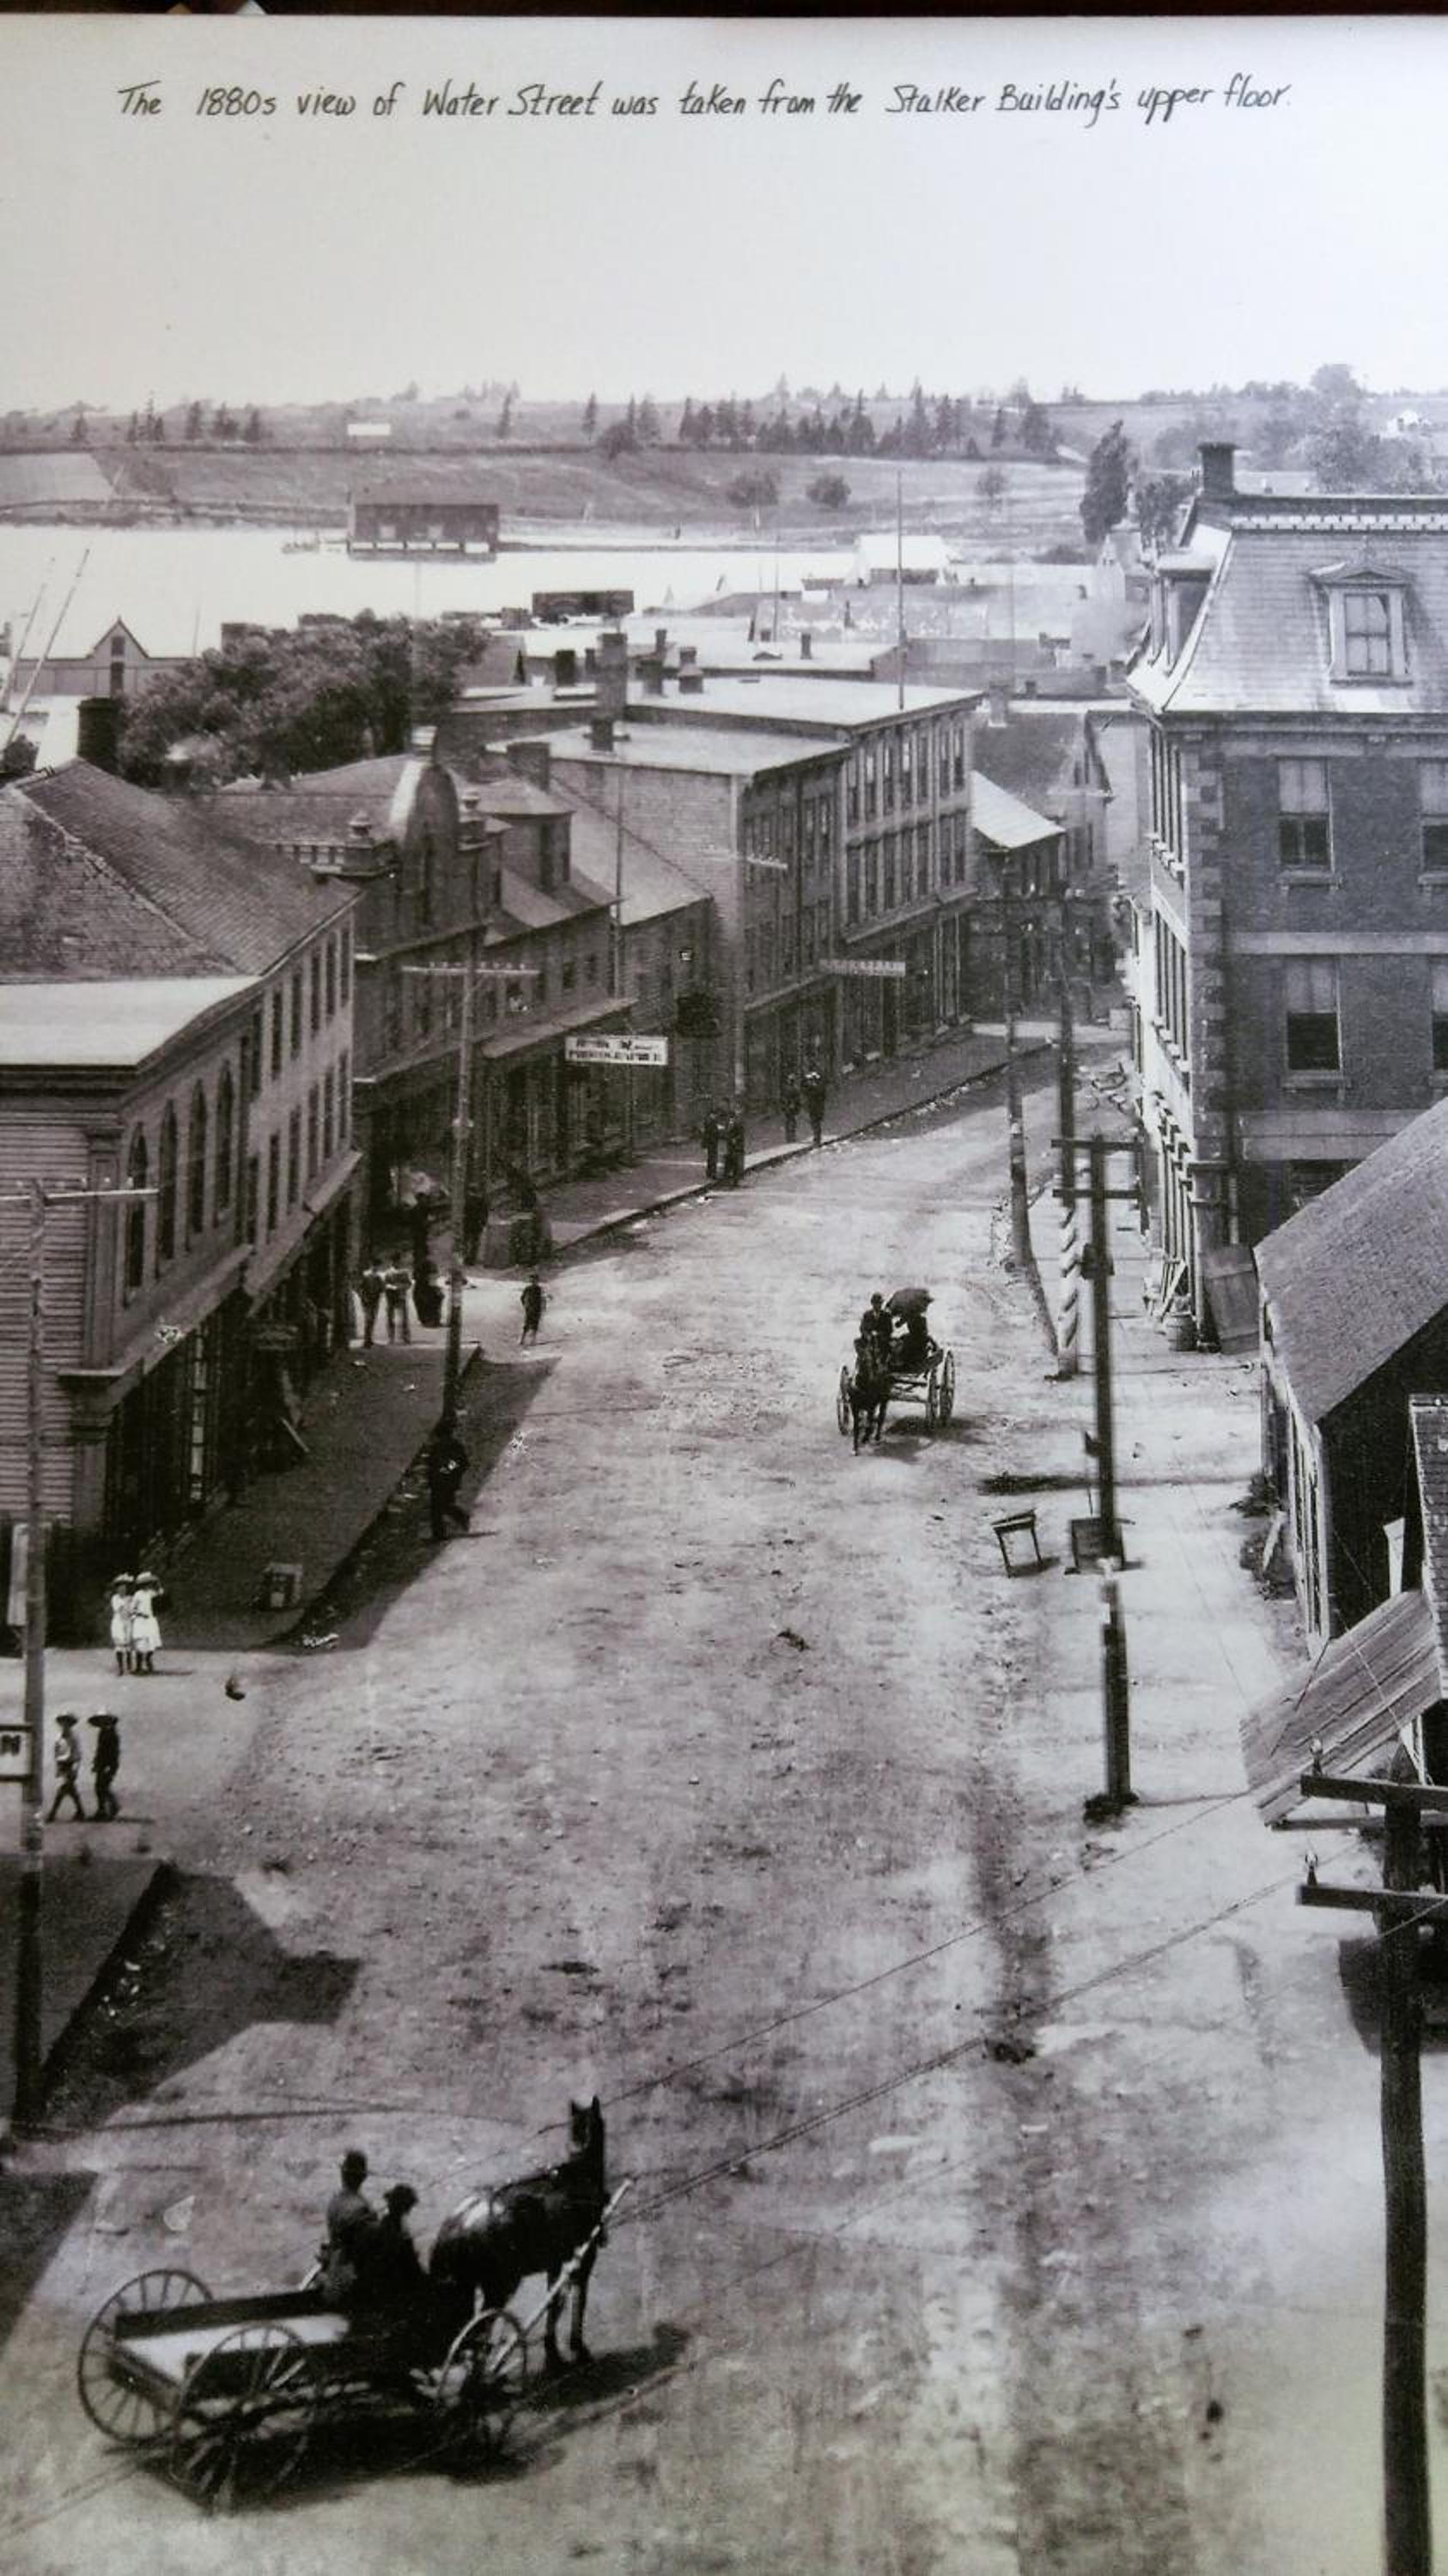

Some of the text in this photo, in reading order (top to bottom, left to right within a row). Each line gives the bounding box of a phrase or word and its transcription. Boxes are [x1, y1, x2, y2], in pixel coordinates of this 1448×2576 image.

[117, 80, 162, 115] The
[197, 88, 277, 116] 1880s
[296, 87, 356, 116] view
[373, 82, 405, 116] of
[422, 81, 499, 116] Water
[507, 81, 604, 116] Street
[611, 97, 660, 115] was
[758, 78, 815, 114] from
[826, 83, 862, 113] the
[996, 79, 1120, 128] Building's
[1137, 87, 1214, 125] upper
